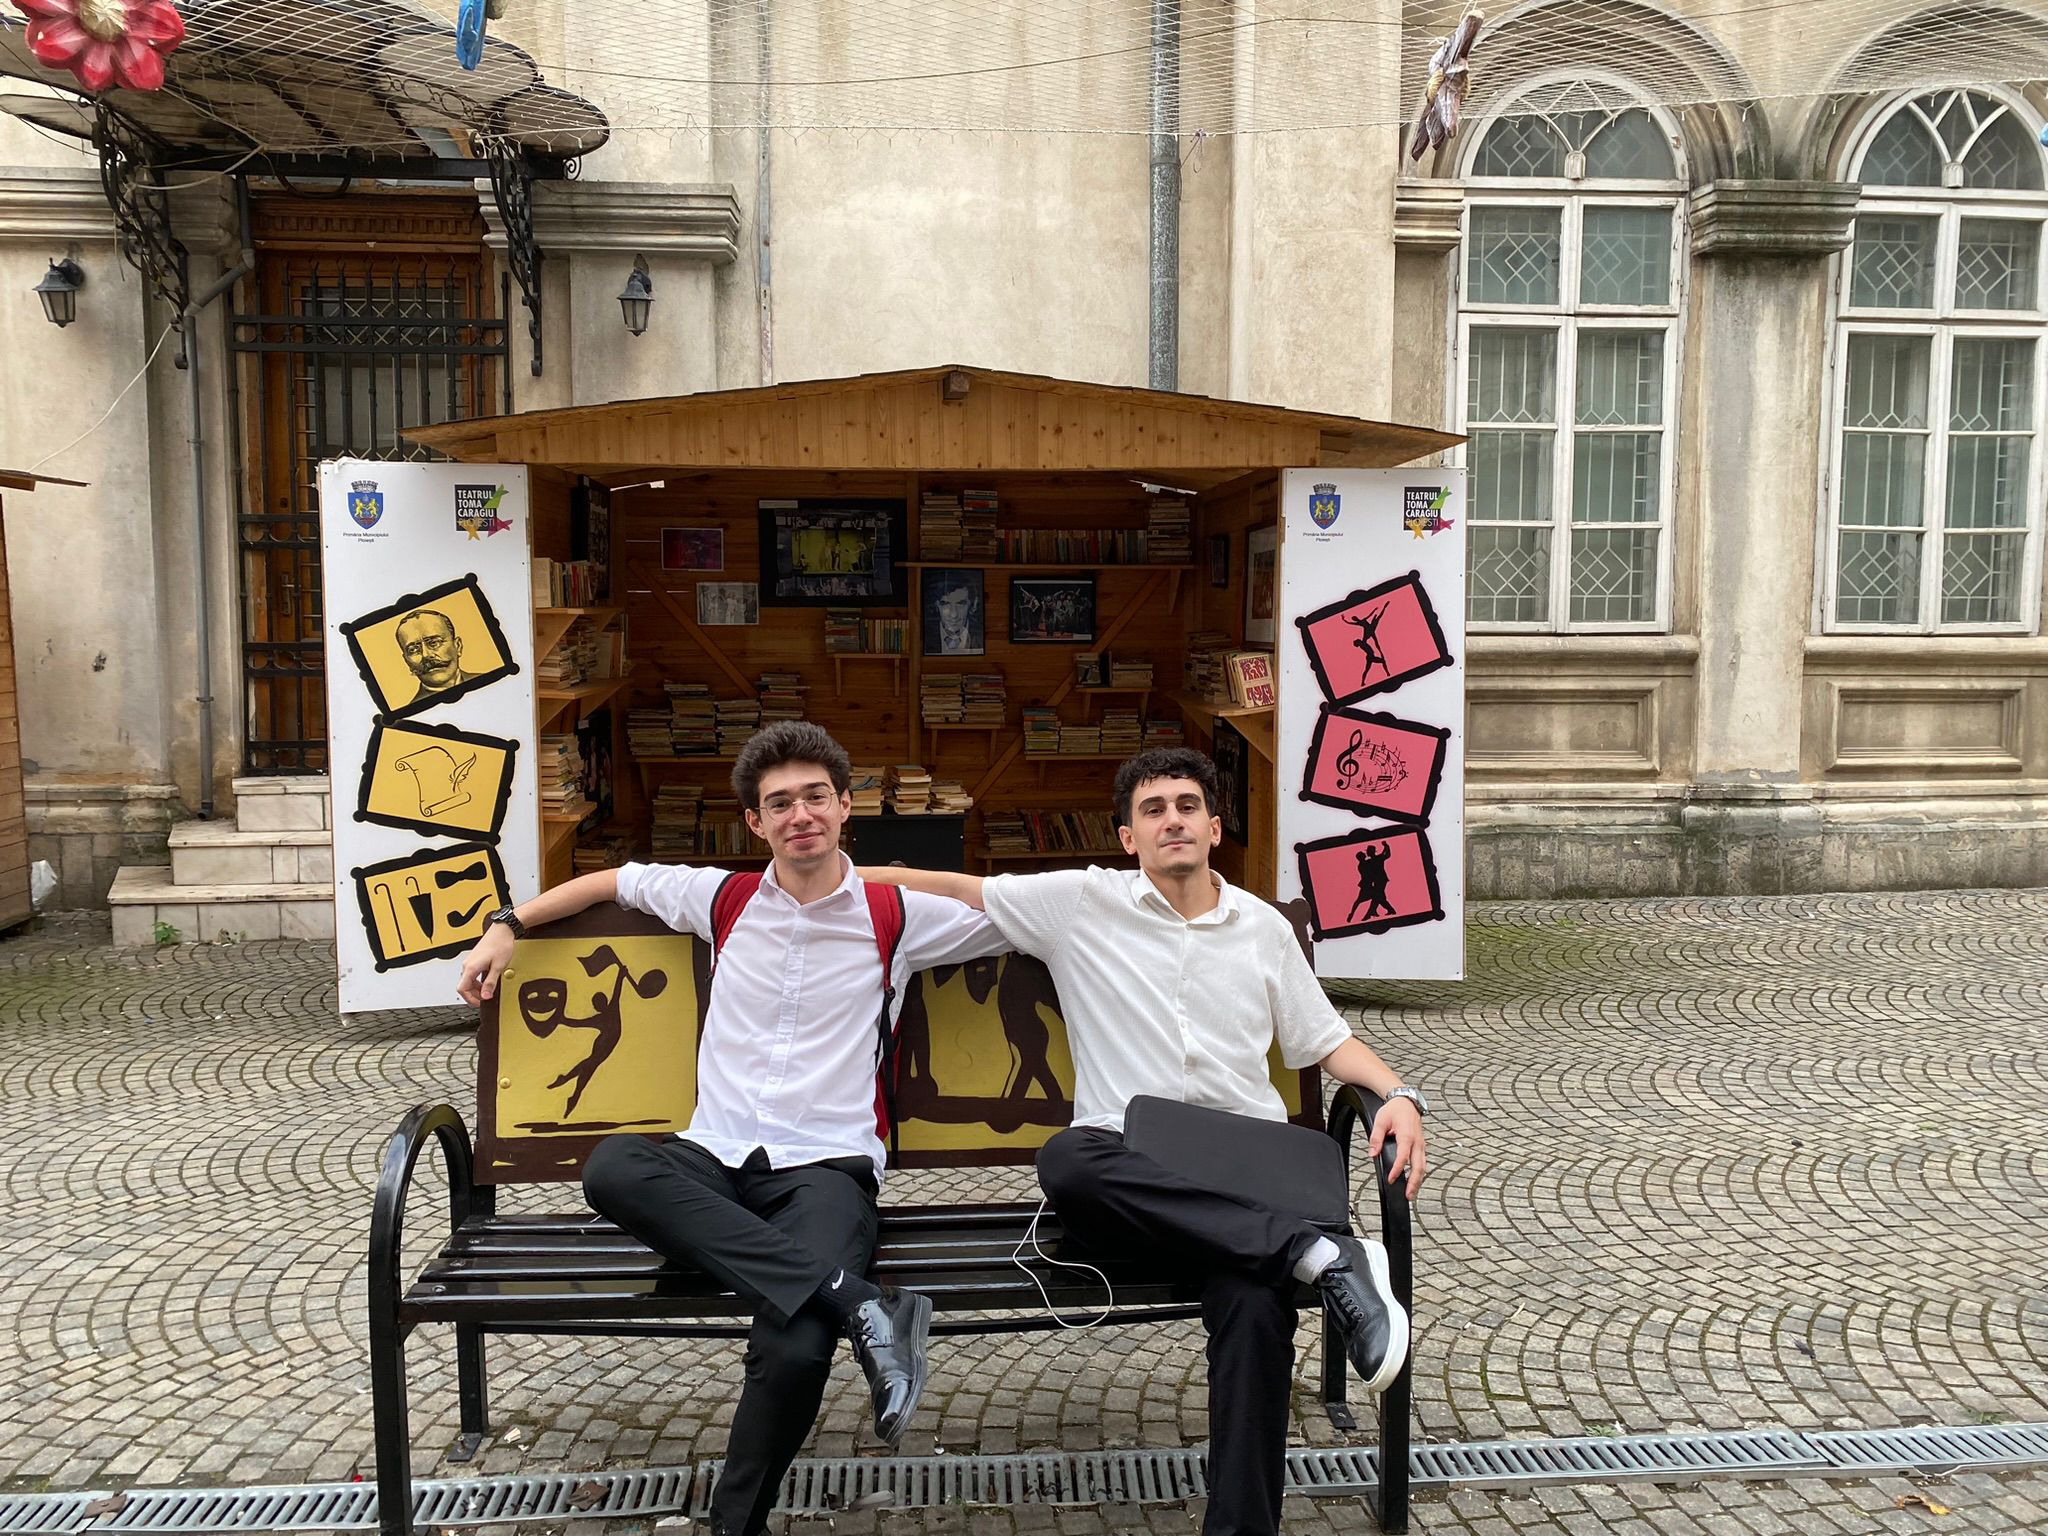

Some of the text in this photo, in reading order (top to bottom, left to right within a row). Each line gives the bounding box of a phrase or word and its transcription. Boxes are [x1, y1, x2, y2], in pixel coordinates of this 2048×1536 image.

[457, 490, 494, 499] TEATRUL
[1406, 492, 1439, 500] TEATRUL
[458, 500, 482, 508] TOMA
[1406, 500, 1428, 509] TOMA
[458, 508, 494, 518] CARAGIU
[1406, 510, 1438, 518] CARAGIU
